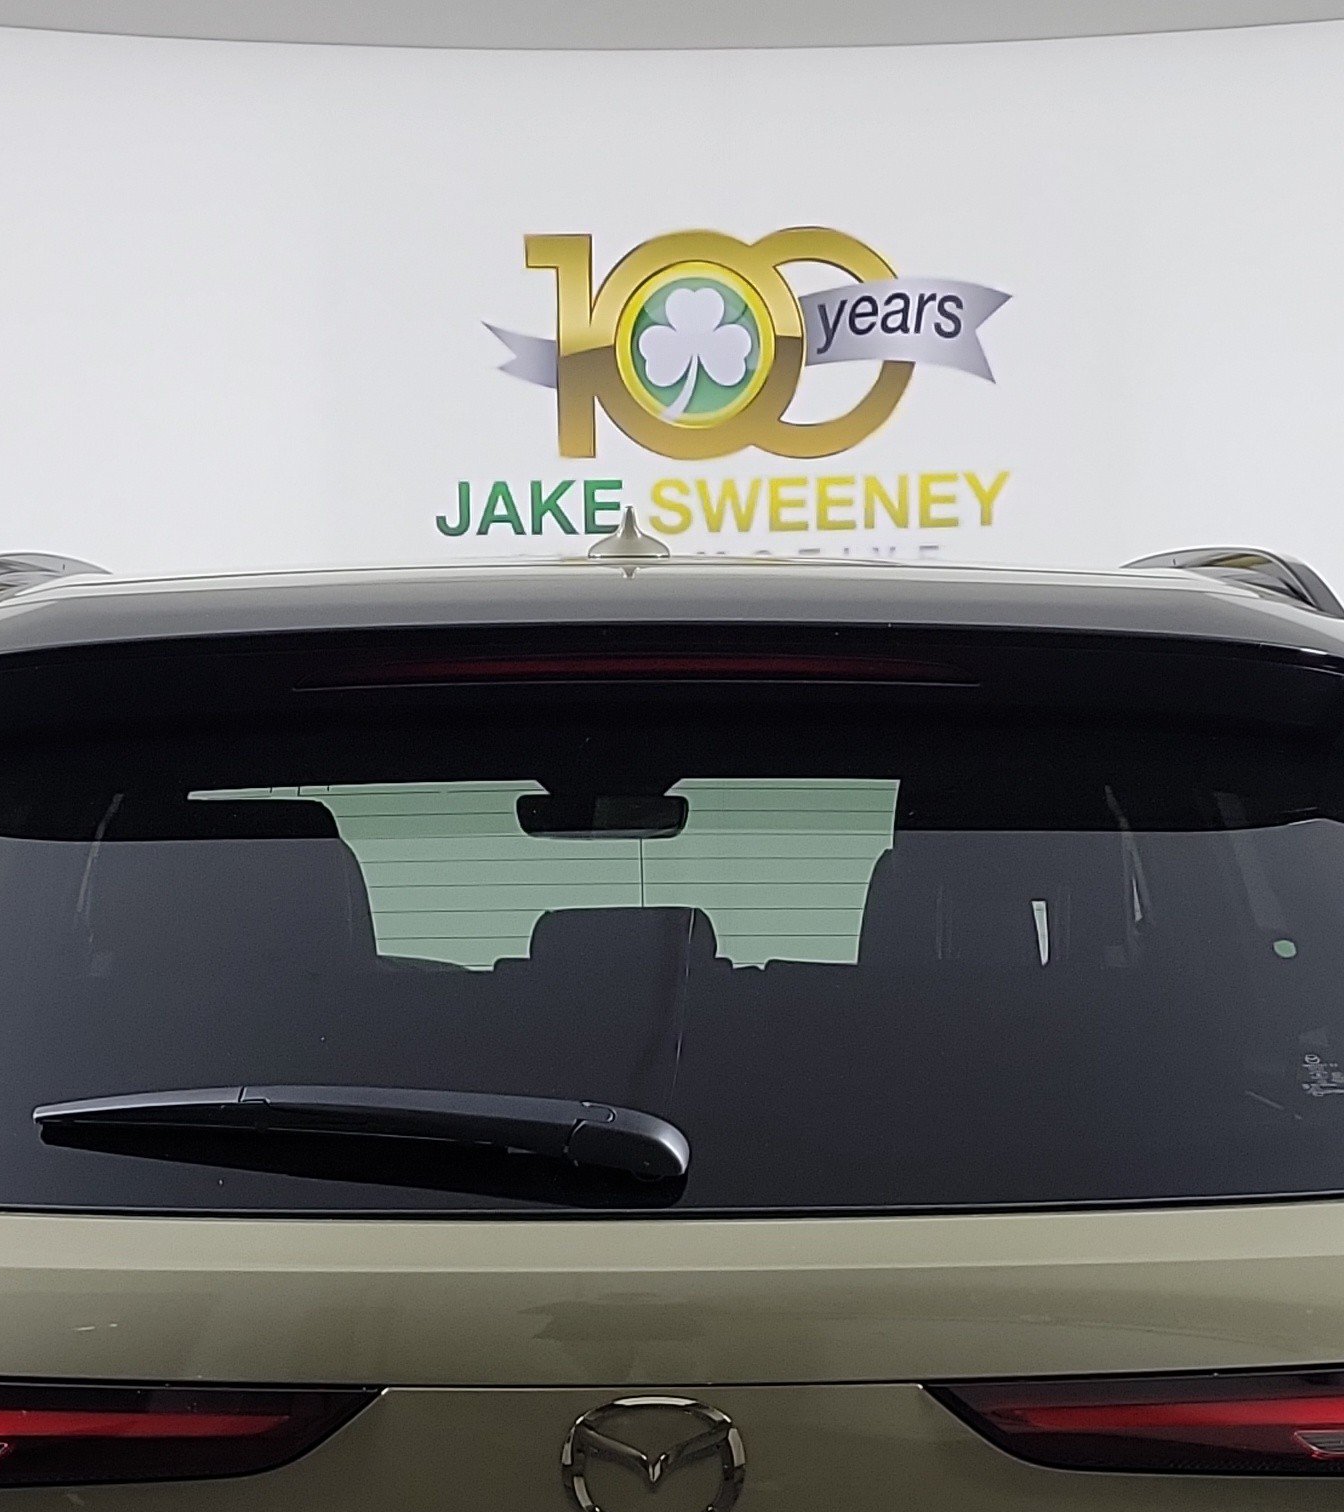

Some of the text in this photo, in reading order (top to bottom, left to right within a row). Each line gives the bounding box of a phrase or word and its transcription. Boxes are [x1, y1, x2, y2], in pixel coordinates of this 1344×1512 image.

[523, 225, 965, 461] 100 years
[435, 470, 1010, 538] JAKE SWEENEY
